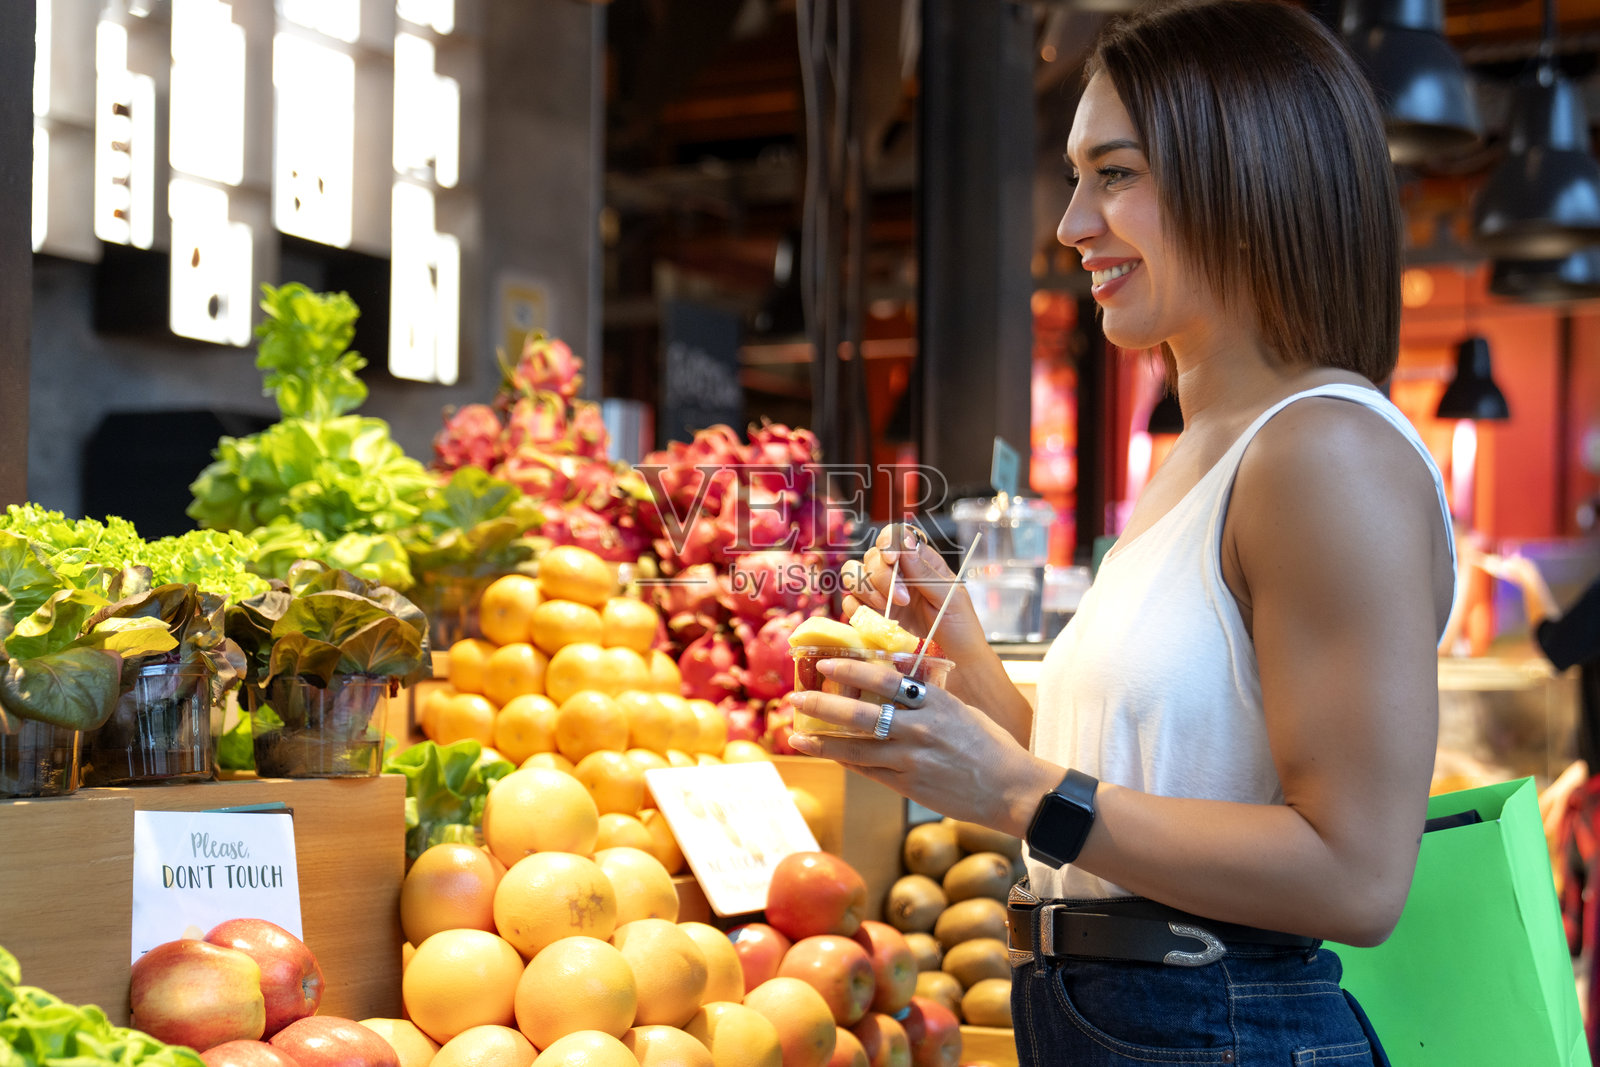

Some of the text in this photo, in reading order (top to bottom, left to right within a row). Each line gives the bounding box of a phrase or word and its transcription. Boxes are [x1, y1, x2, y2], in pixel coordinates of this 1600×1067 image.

[190, 832, 250, 859] Please,
[162, 864, 283, 888] DON'T TOUCH
